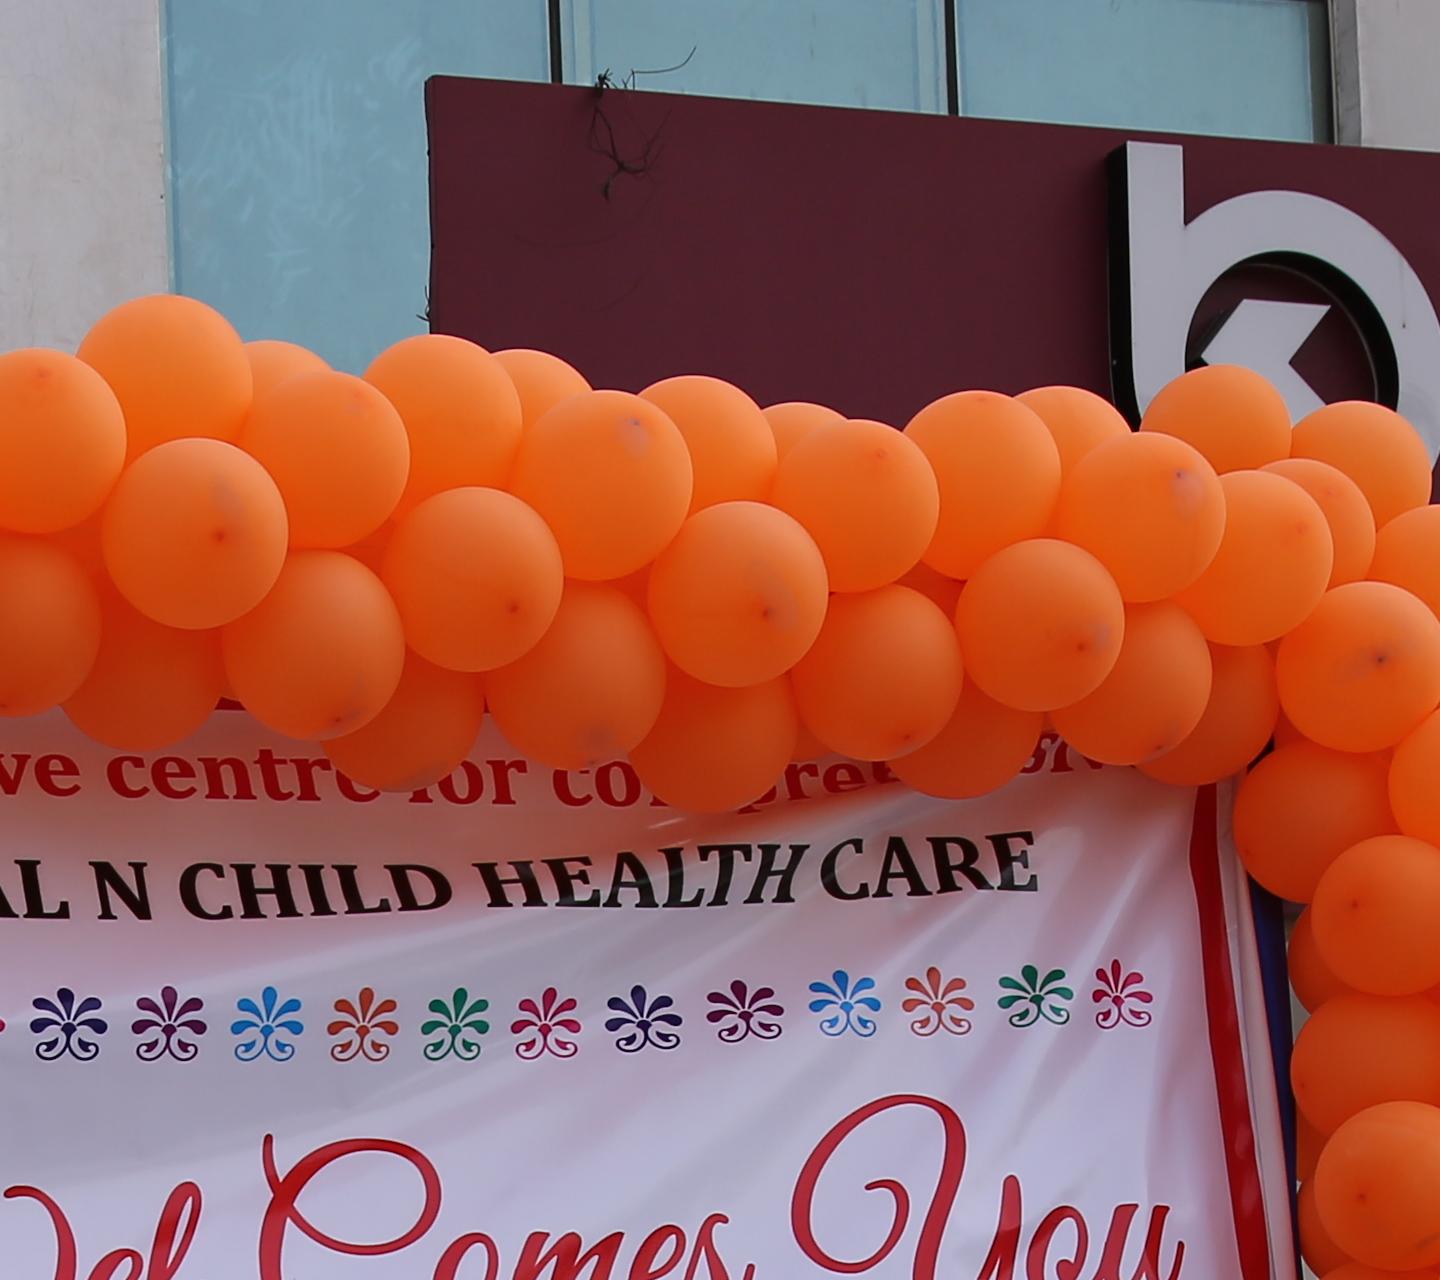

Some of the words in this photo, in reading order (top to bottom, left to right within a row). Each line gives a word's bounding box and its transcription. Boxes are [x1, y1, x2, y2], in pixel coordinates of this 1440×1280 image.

[408, 758, 529, 806] or
[87, 859, 155, 922] N
[177, 860, 454, 922] CHILD
[470, 842, 812, 909] HEALTH
[817, 829, 1041, 900] CARE
